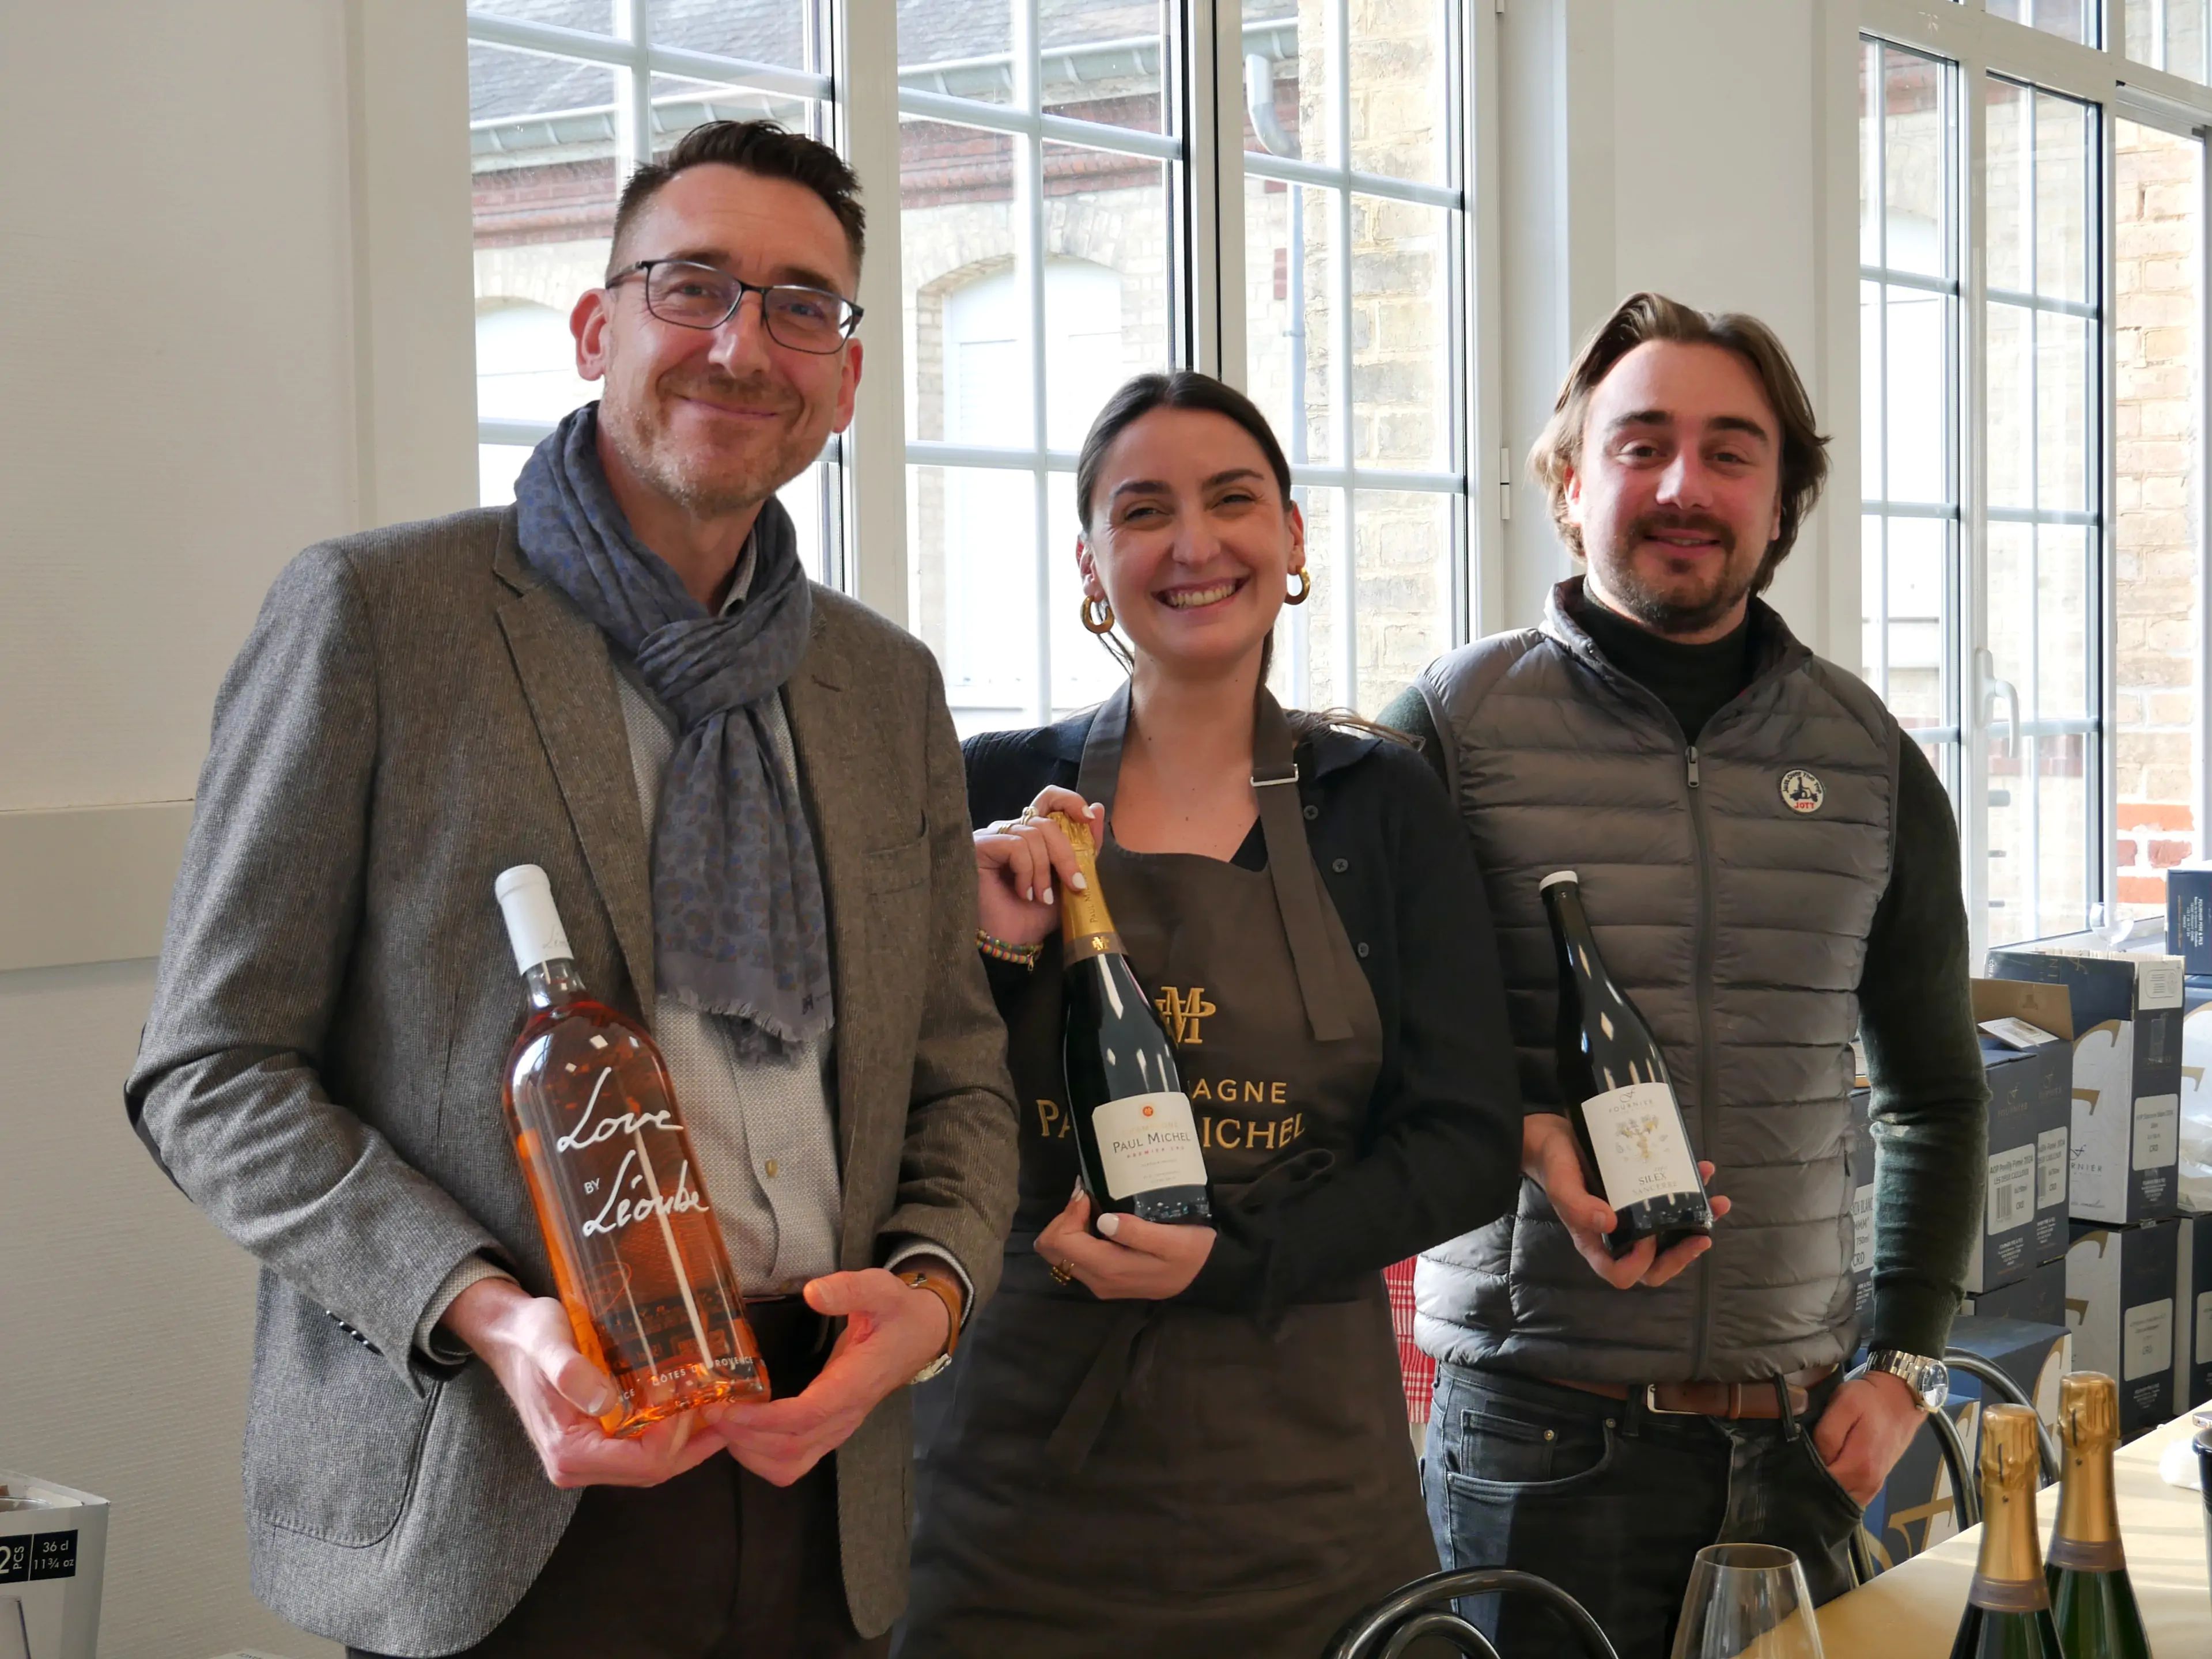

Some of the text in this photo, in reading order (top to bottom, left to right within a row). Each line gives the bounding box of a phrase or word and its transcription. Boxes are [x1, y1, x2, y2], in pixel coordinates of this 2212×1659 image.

[1803, 772, 1815, 781] The
[1189, 1078, 1287, 1104] AGNE
[557, 1066, 685, 1152] Love
[1201, 1112, 1306, 1150] ICHEL
[1113, 1131, 1192, 1153] PAUL MICHEL
[2071, 1162, 2103, 1172] RNIER
[584, 1177, 600, 1195] BY
[1638, 1172, 1667, 1185] SILEX
[1852, 1251, 1865, 1267] CRD
[714, 1355, 754, 1368] ROVENCE
[43, 1539, 69, 1553] 36 cl
[13, 1546, 24, 1570] PCS
[63, 1559, 74, 1567] oz
